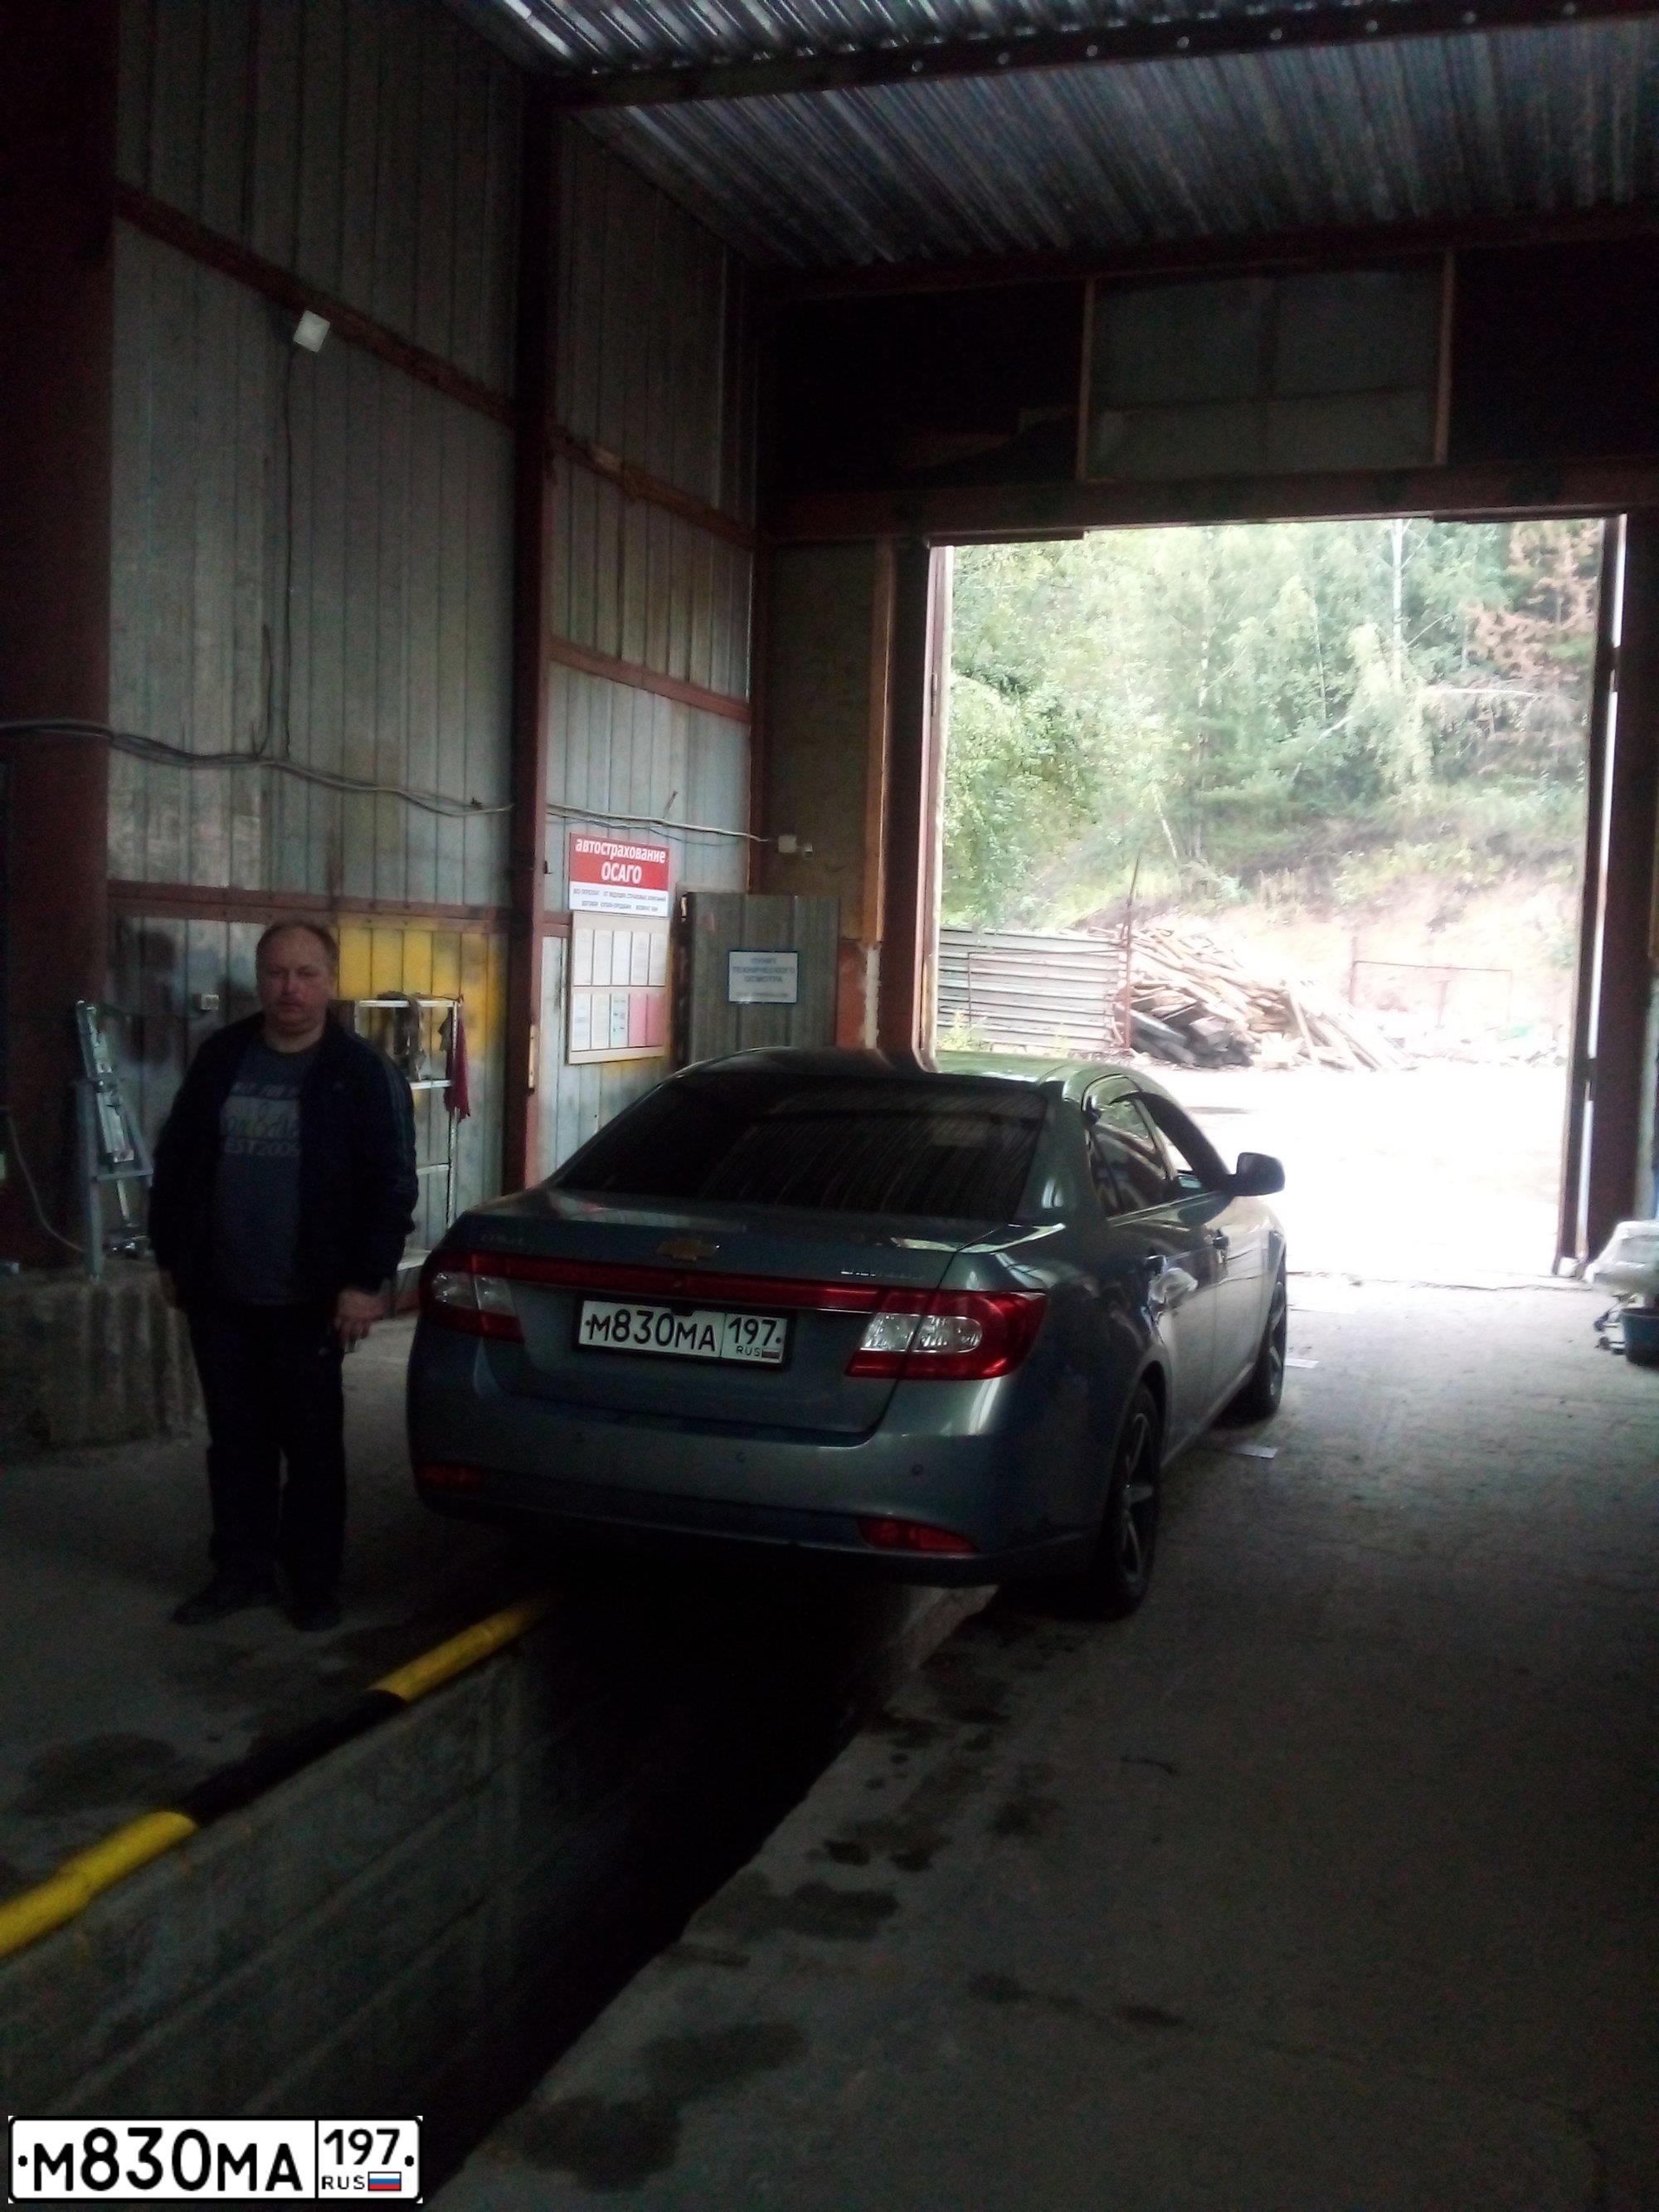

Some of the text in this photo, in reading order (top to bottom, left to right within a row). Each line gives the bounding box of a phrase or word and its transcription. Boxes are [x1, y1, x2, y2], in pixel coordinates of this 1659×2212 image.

[575, 838, 666, 864] автострахование
[601, 861, 642, 884] ОСАГО
[728, 1317, 778, 1346] 197
[736, 1345, 761, 1357] RUS
